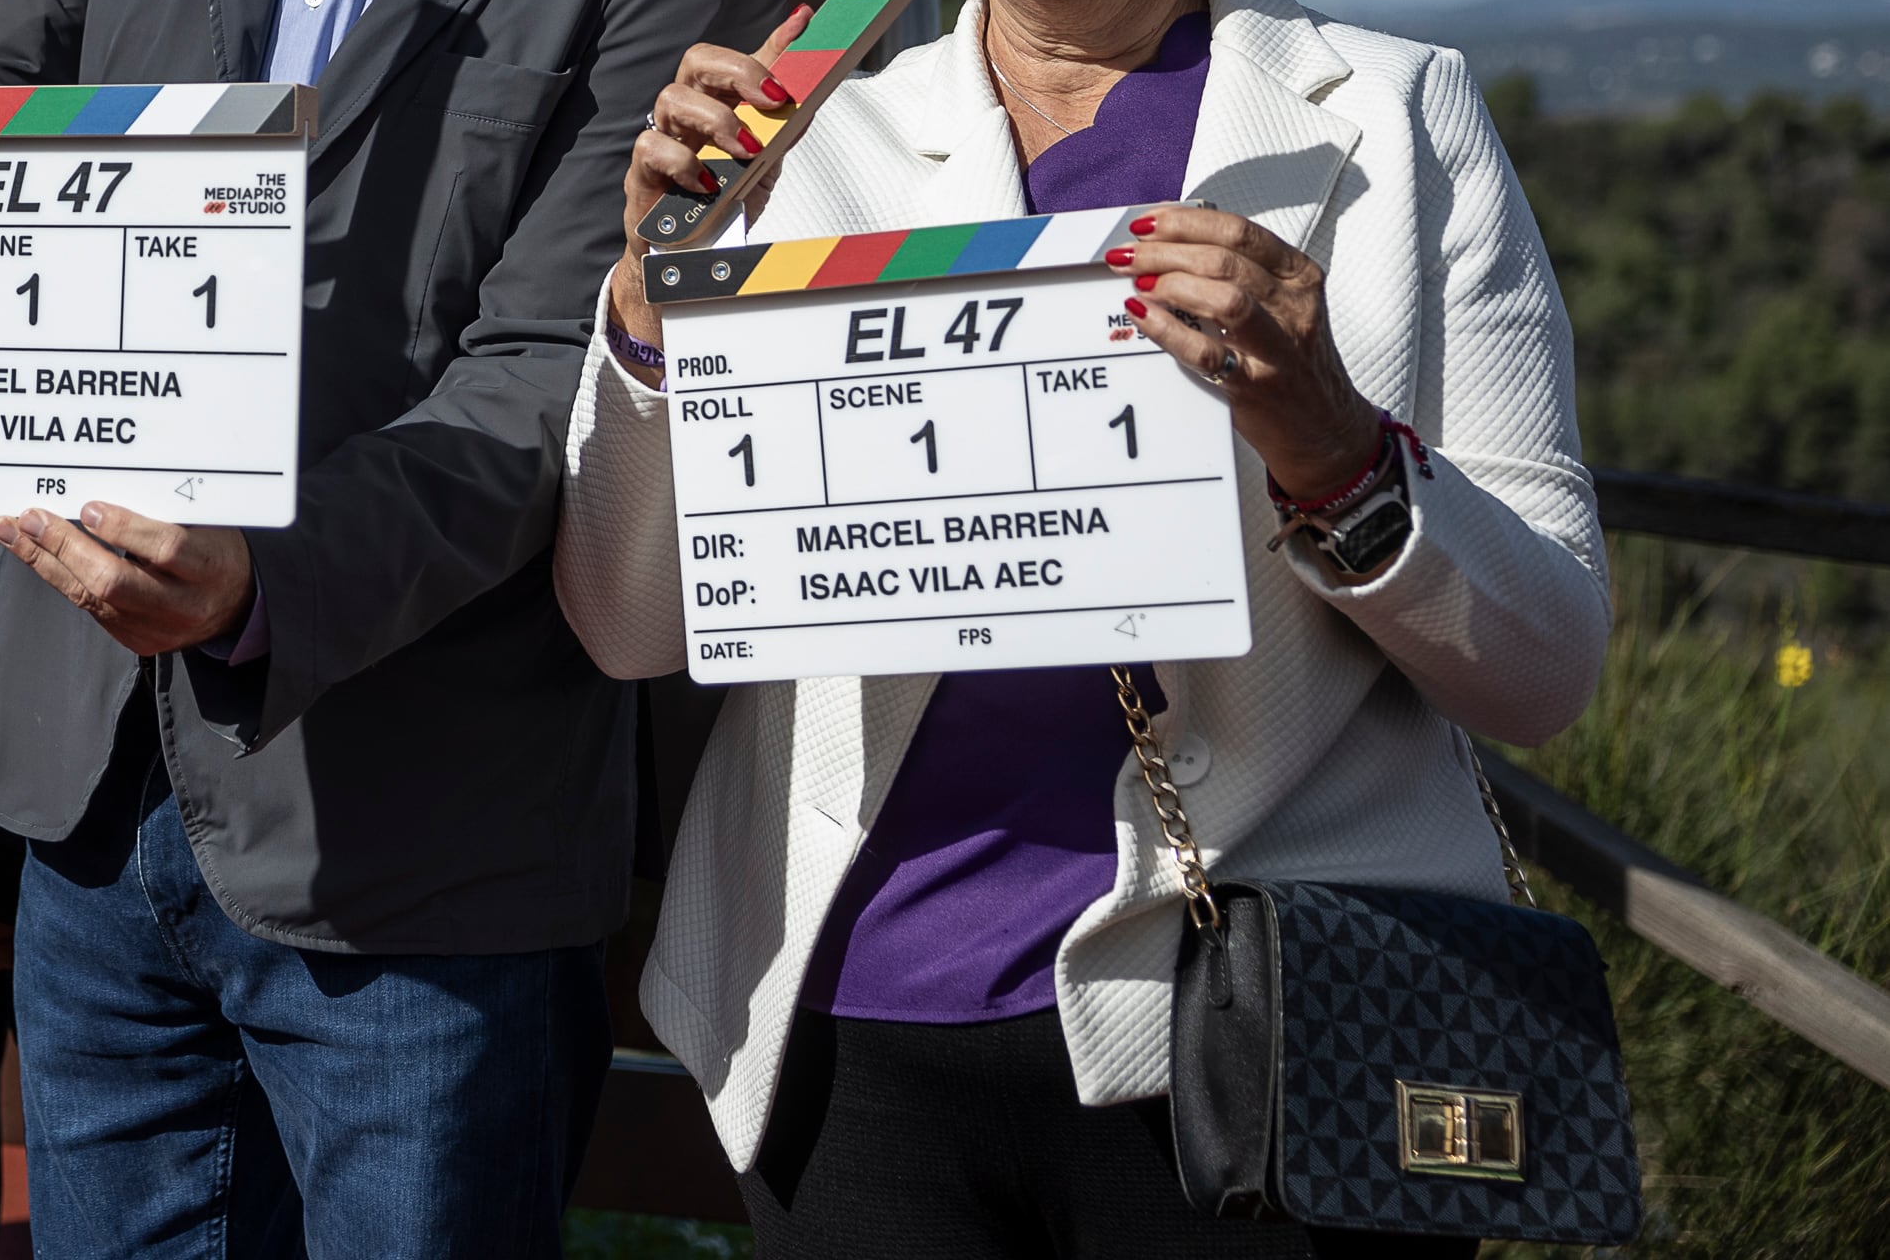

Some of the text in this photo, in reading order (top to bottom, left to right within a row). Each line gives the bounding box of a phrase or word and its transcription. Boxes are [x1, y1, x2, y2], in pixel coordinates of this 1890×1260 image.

[56, 161, 133, 213] 47
[204, 187, 287, 201] MEDIAPRO
[256, 173, 286, 186] THE
[228, 201, 286, 215] STUDIO
[134, 235, 198, 258] TAKE
[16, 272, 40, 326] 1
[192, 274, 217, 329] 1
[844, 297, 1024, 364] EL 47
[677, 354, 733, 378] PROD.
[1036, 366, 1108, 393] TAKE
[35, 368, 182, 398] BARRENA
[829, 381, 923, 410] SCENE
[682, 396, 754, 422] ROLL
[0, 414, 66, 442] VILA
[73, 417, 136, 445] AEC
[1108, 404, 1138, 460] 1
[728, 433, 756, 488] 1
[909, 419, 938, 474] 1
[36, 477, 66, 495] FPS
[692, 507, 1110, 560] DIR: MARCEL BARRENA
[696, 558, 1063, 607] DoP: ISAAC VILA AEC
[700, 641, 753, 660] DATE:
[958, 627, 992, 646] FPS
